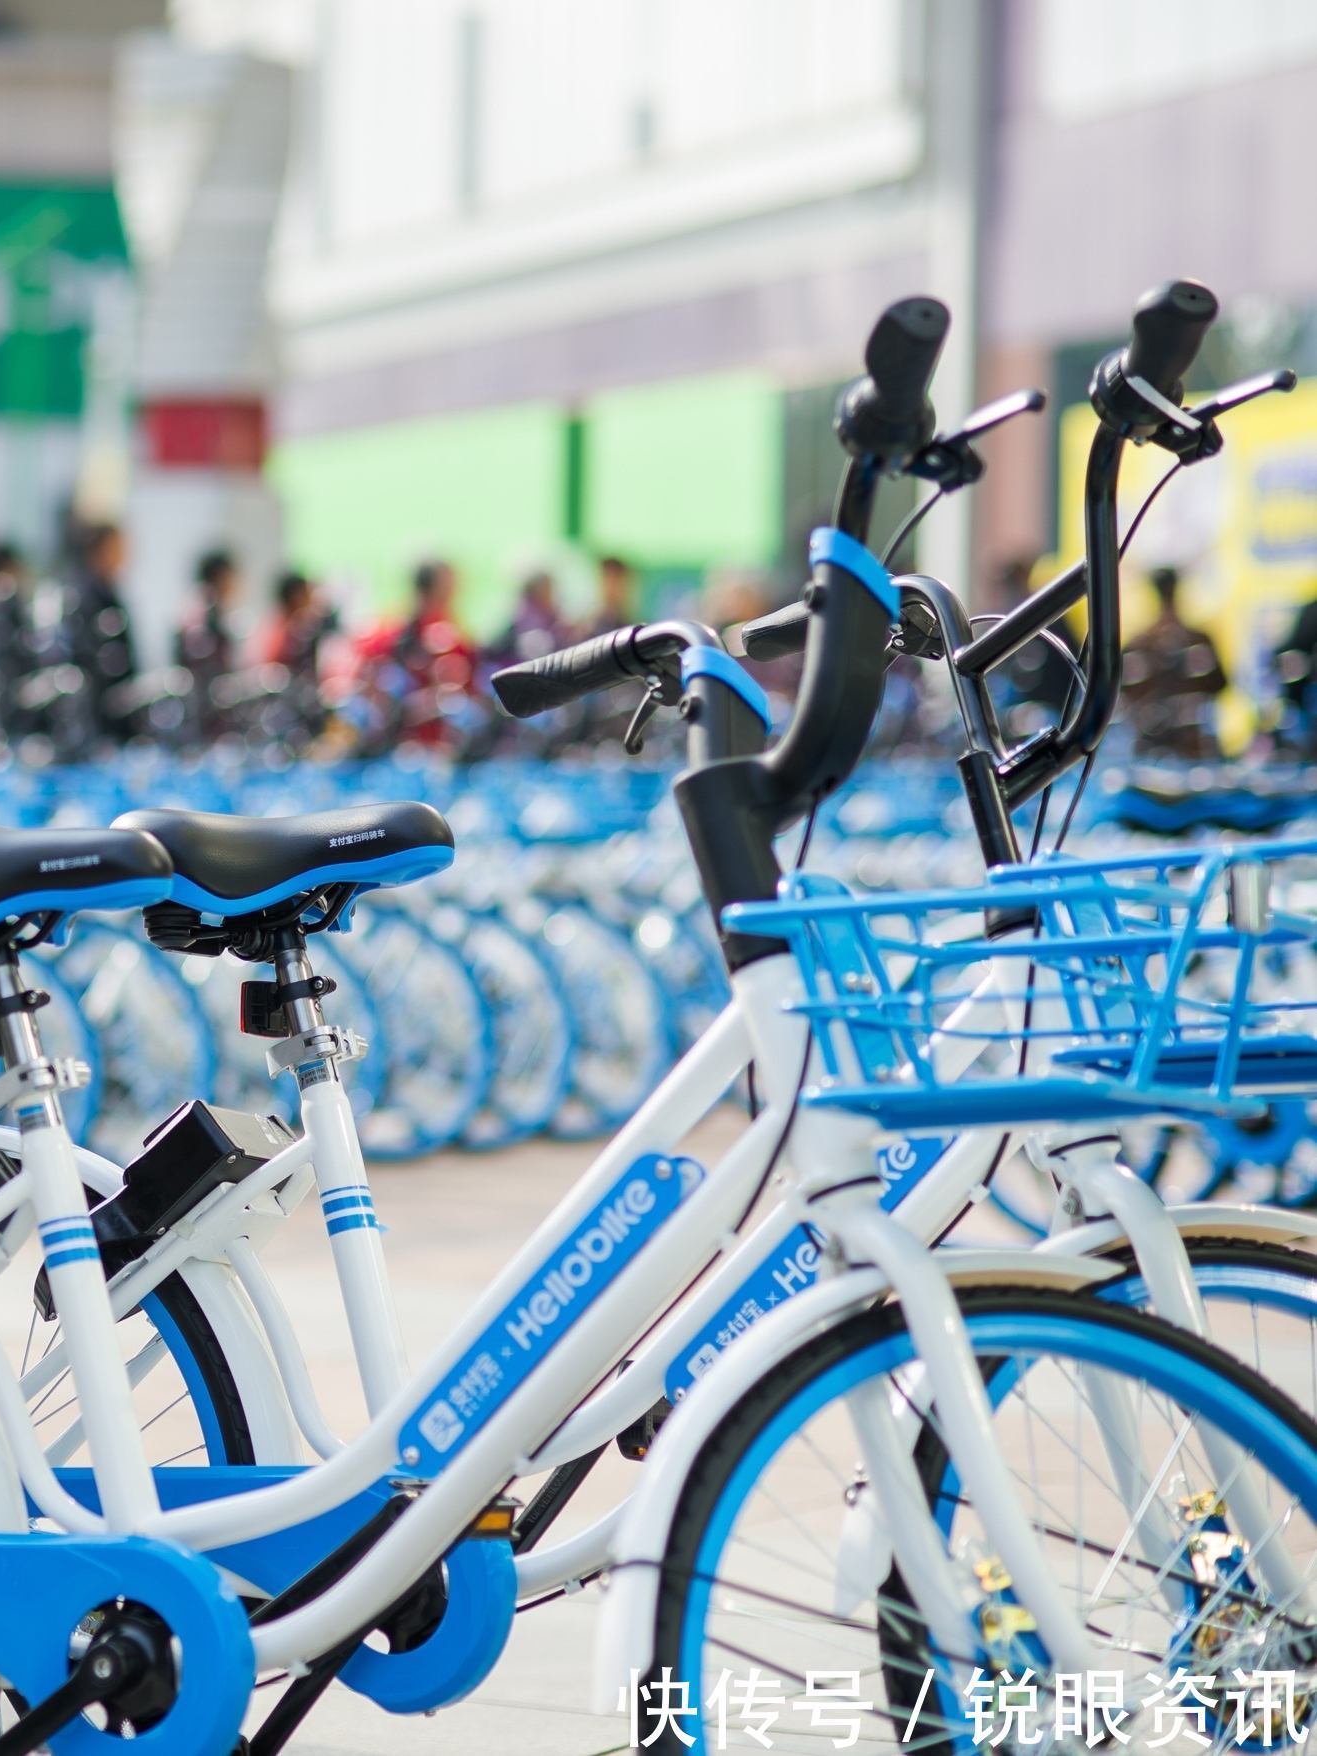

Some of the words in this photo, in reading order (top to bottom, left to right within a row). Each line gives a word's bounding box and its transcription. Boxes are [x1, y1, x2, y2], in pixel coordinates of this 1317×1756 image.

[329, 829, 386, 848] 支付宝扫码骑车
[505, 1179, 656, 1350] Hellobike
